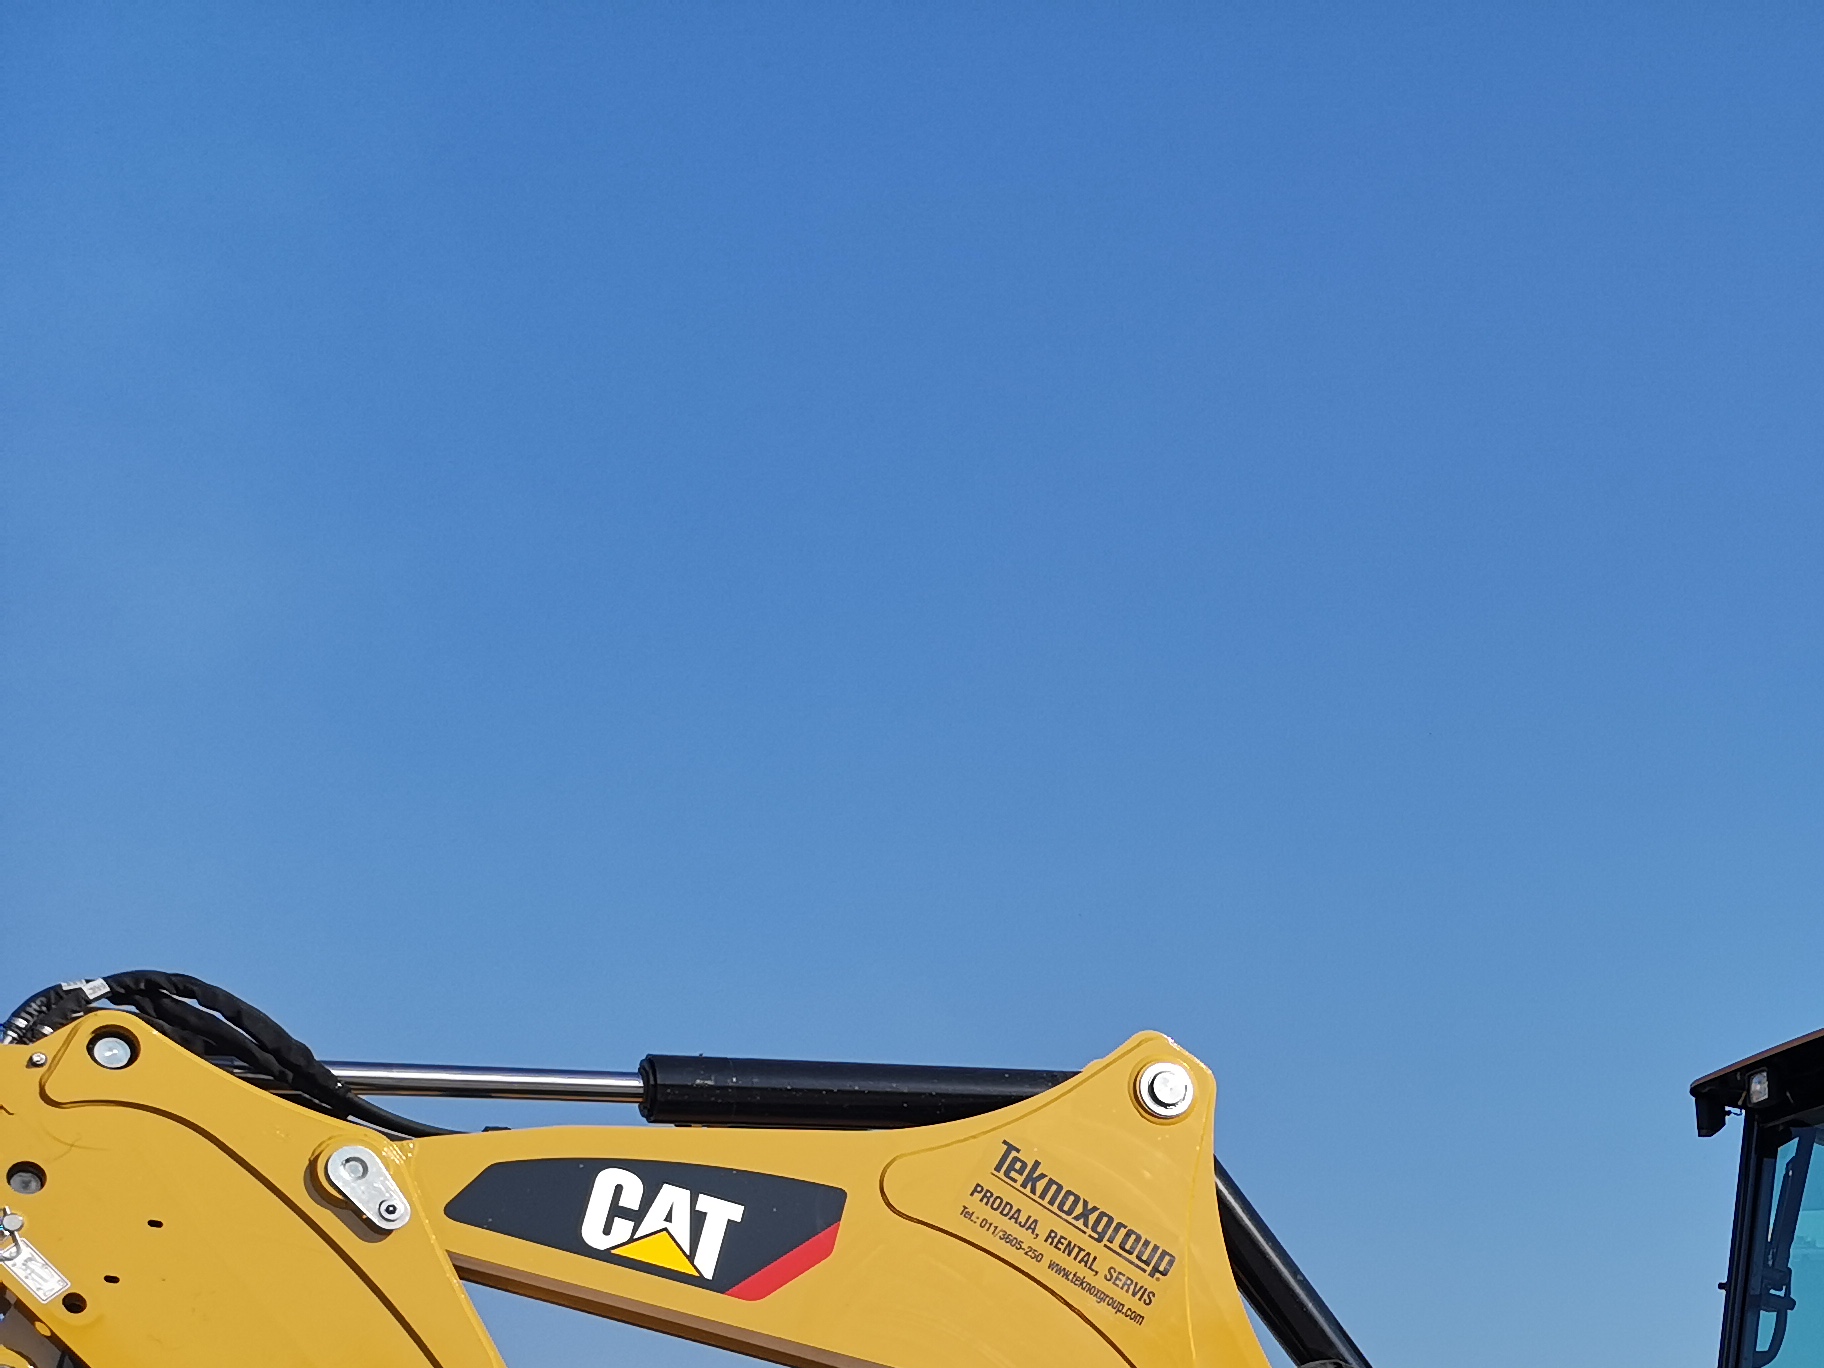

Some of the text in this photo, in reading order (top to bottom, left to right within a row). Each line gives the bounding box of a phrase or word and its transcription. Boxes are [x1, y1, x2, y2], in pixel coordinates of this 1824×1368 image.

[581, 1167, 745, 1280] CAT
[969, 1182, 1156, 1306] PRODAJA, RENTAL, SERVIS
[993, 1138, 1176, 1279] Teknoxgroup
[1048, 1259, 1145, 1326] www.teknoxgroup.com
